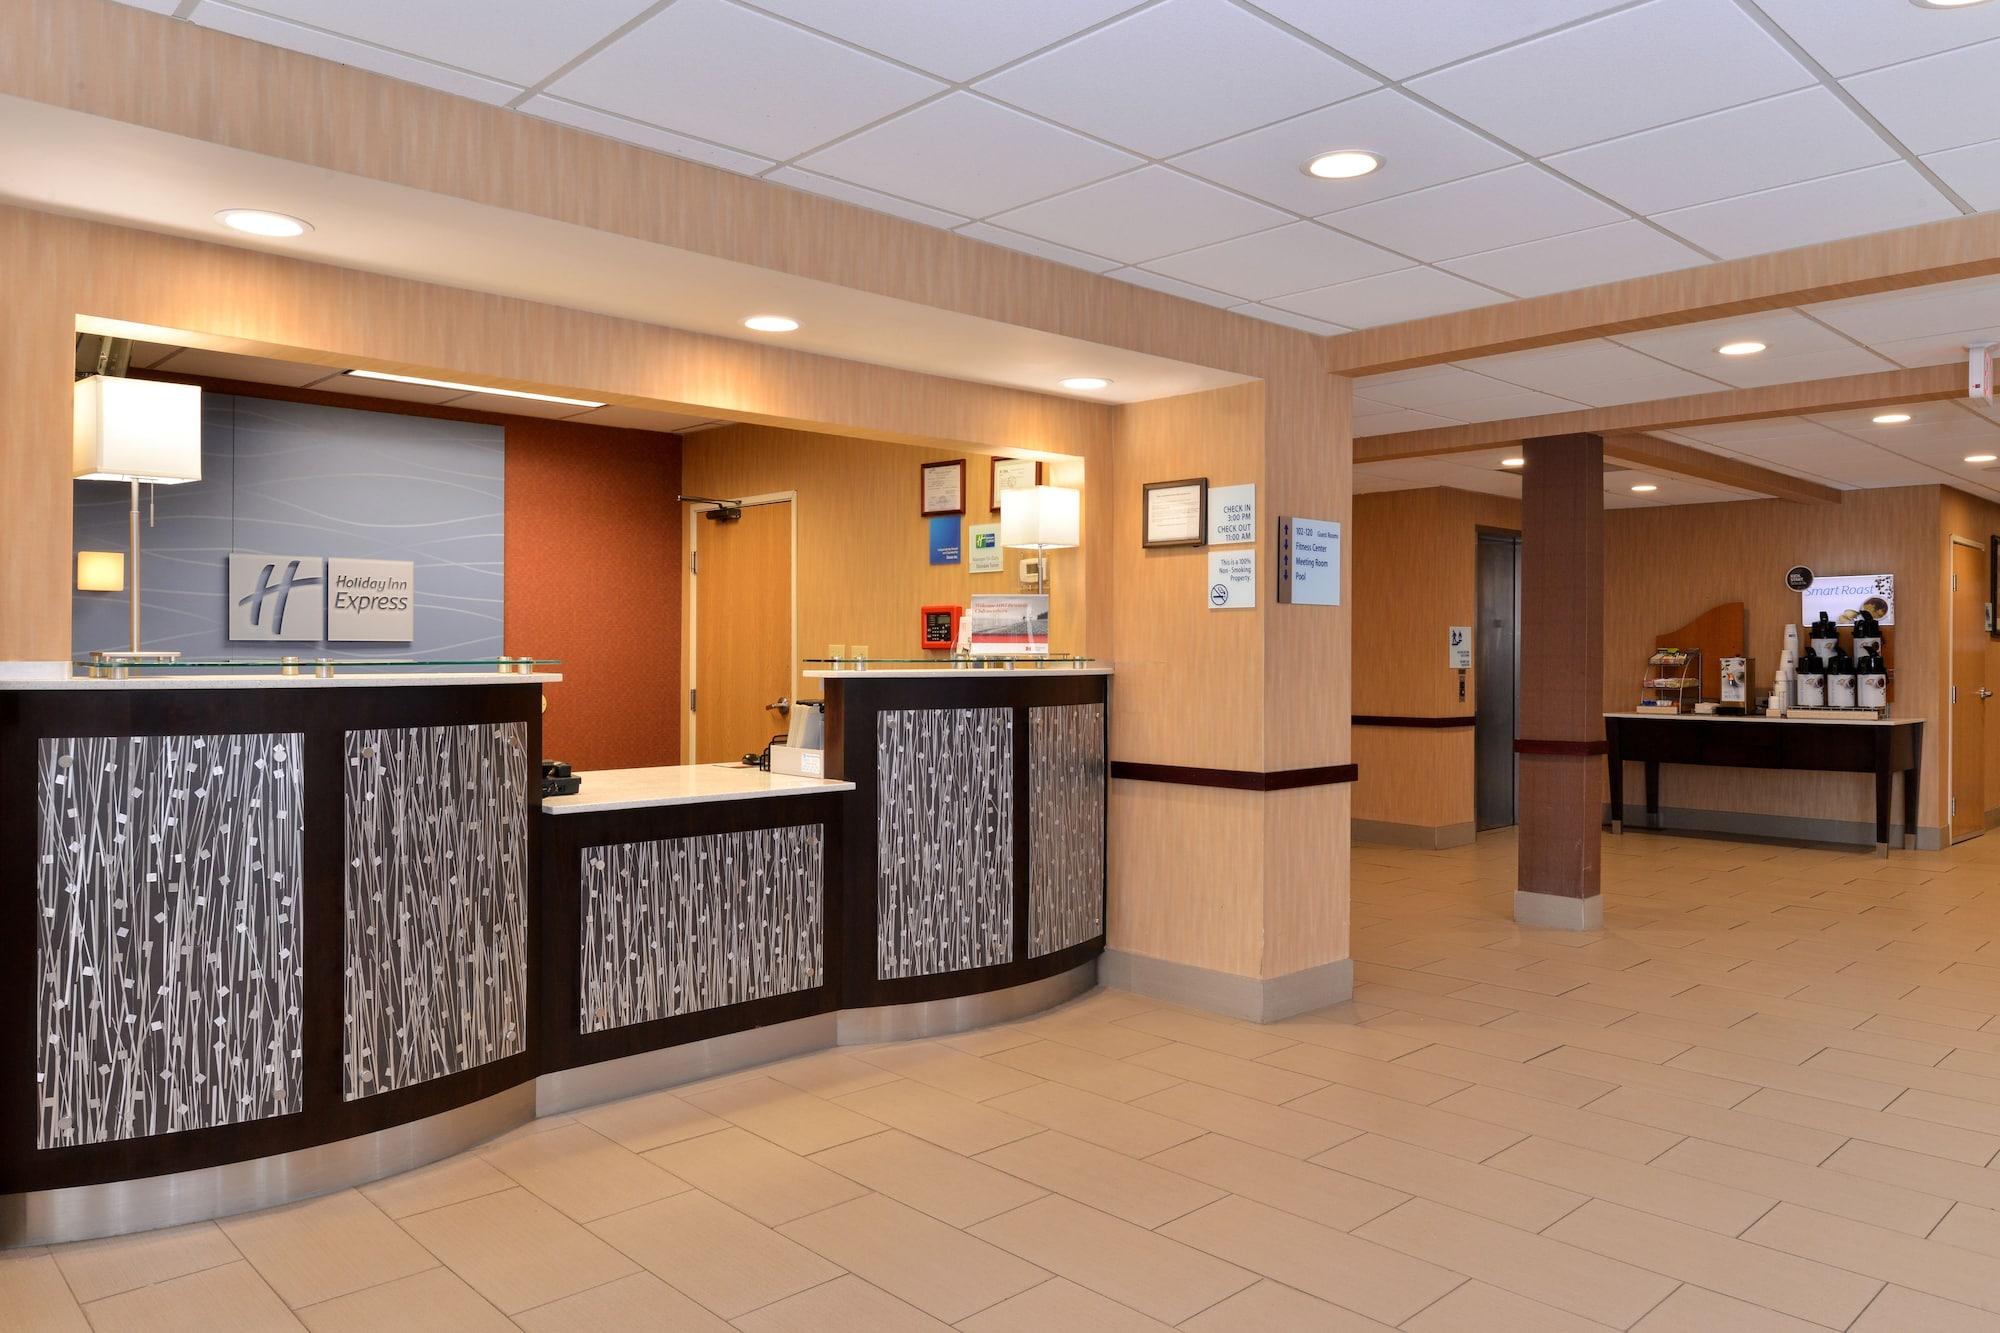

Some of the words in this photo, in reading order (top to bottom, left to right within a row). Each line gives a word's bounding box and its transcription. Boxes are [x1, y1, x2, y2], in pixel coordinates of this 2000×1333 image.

[1223, 504, 1243, 513] CHECK
[1244, 503, 1251, 511] IN
[1228, 513, 1240, 521] 3:00
[1241, 512, 1251, 520] PM
[1218, 524, 1237, 534] CHECK
[1238, 523, 1251, 532] OUT
[1241, 532, 1251, 540] AM
[1296, 541, 1311, 552] Fitness
[1312, 543, 1327, 553] Center
[1296, 557, 1314, 568] Meeting
[1315, 558, 1329, 568] Room
[1296, 571, 1306, 581] Pool
[336, 575, 386, 592] Holiday
[387, 577, 407, 590] Inn
[1840, 584, 1874, 595] Roast
[335, 592, 408, 616] Express
